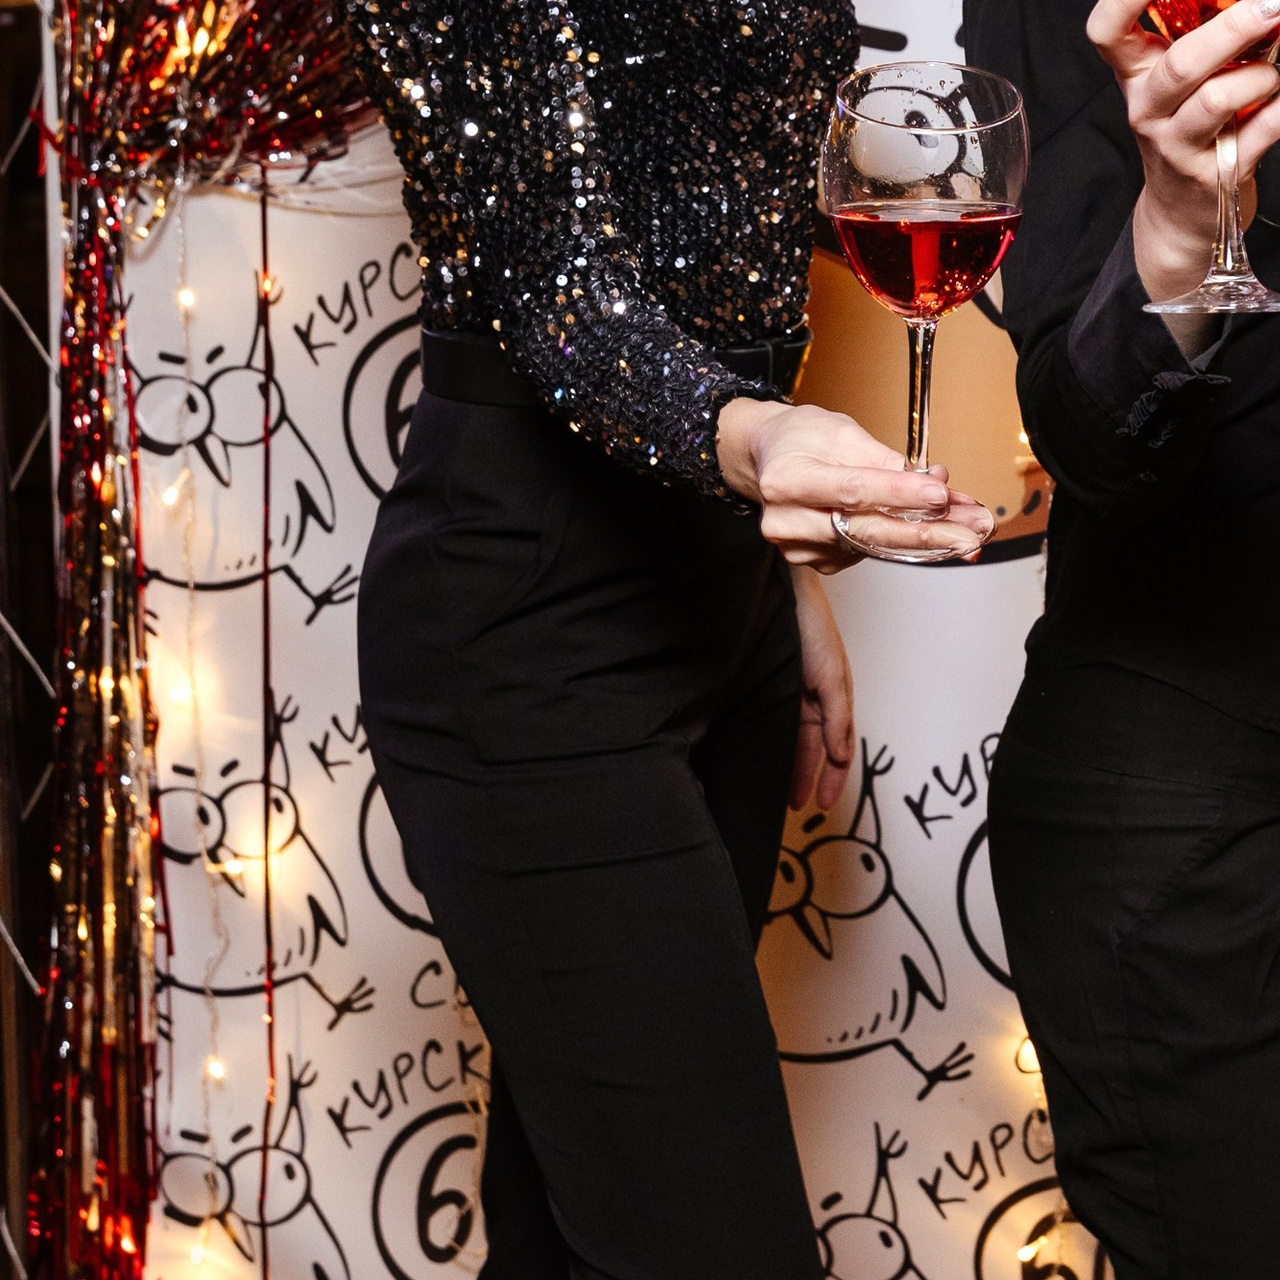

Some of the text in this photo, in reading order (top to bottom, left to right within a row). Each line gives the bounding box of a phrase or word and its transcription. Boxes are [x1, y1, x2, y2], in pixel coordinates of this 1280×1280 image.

[293, 240, 424, 366] КУРС
[326, 1038, 491, 1148] КУРСК
[918, 1108, 1054, 1221] КУРС
